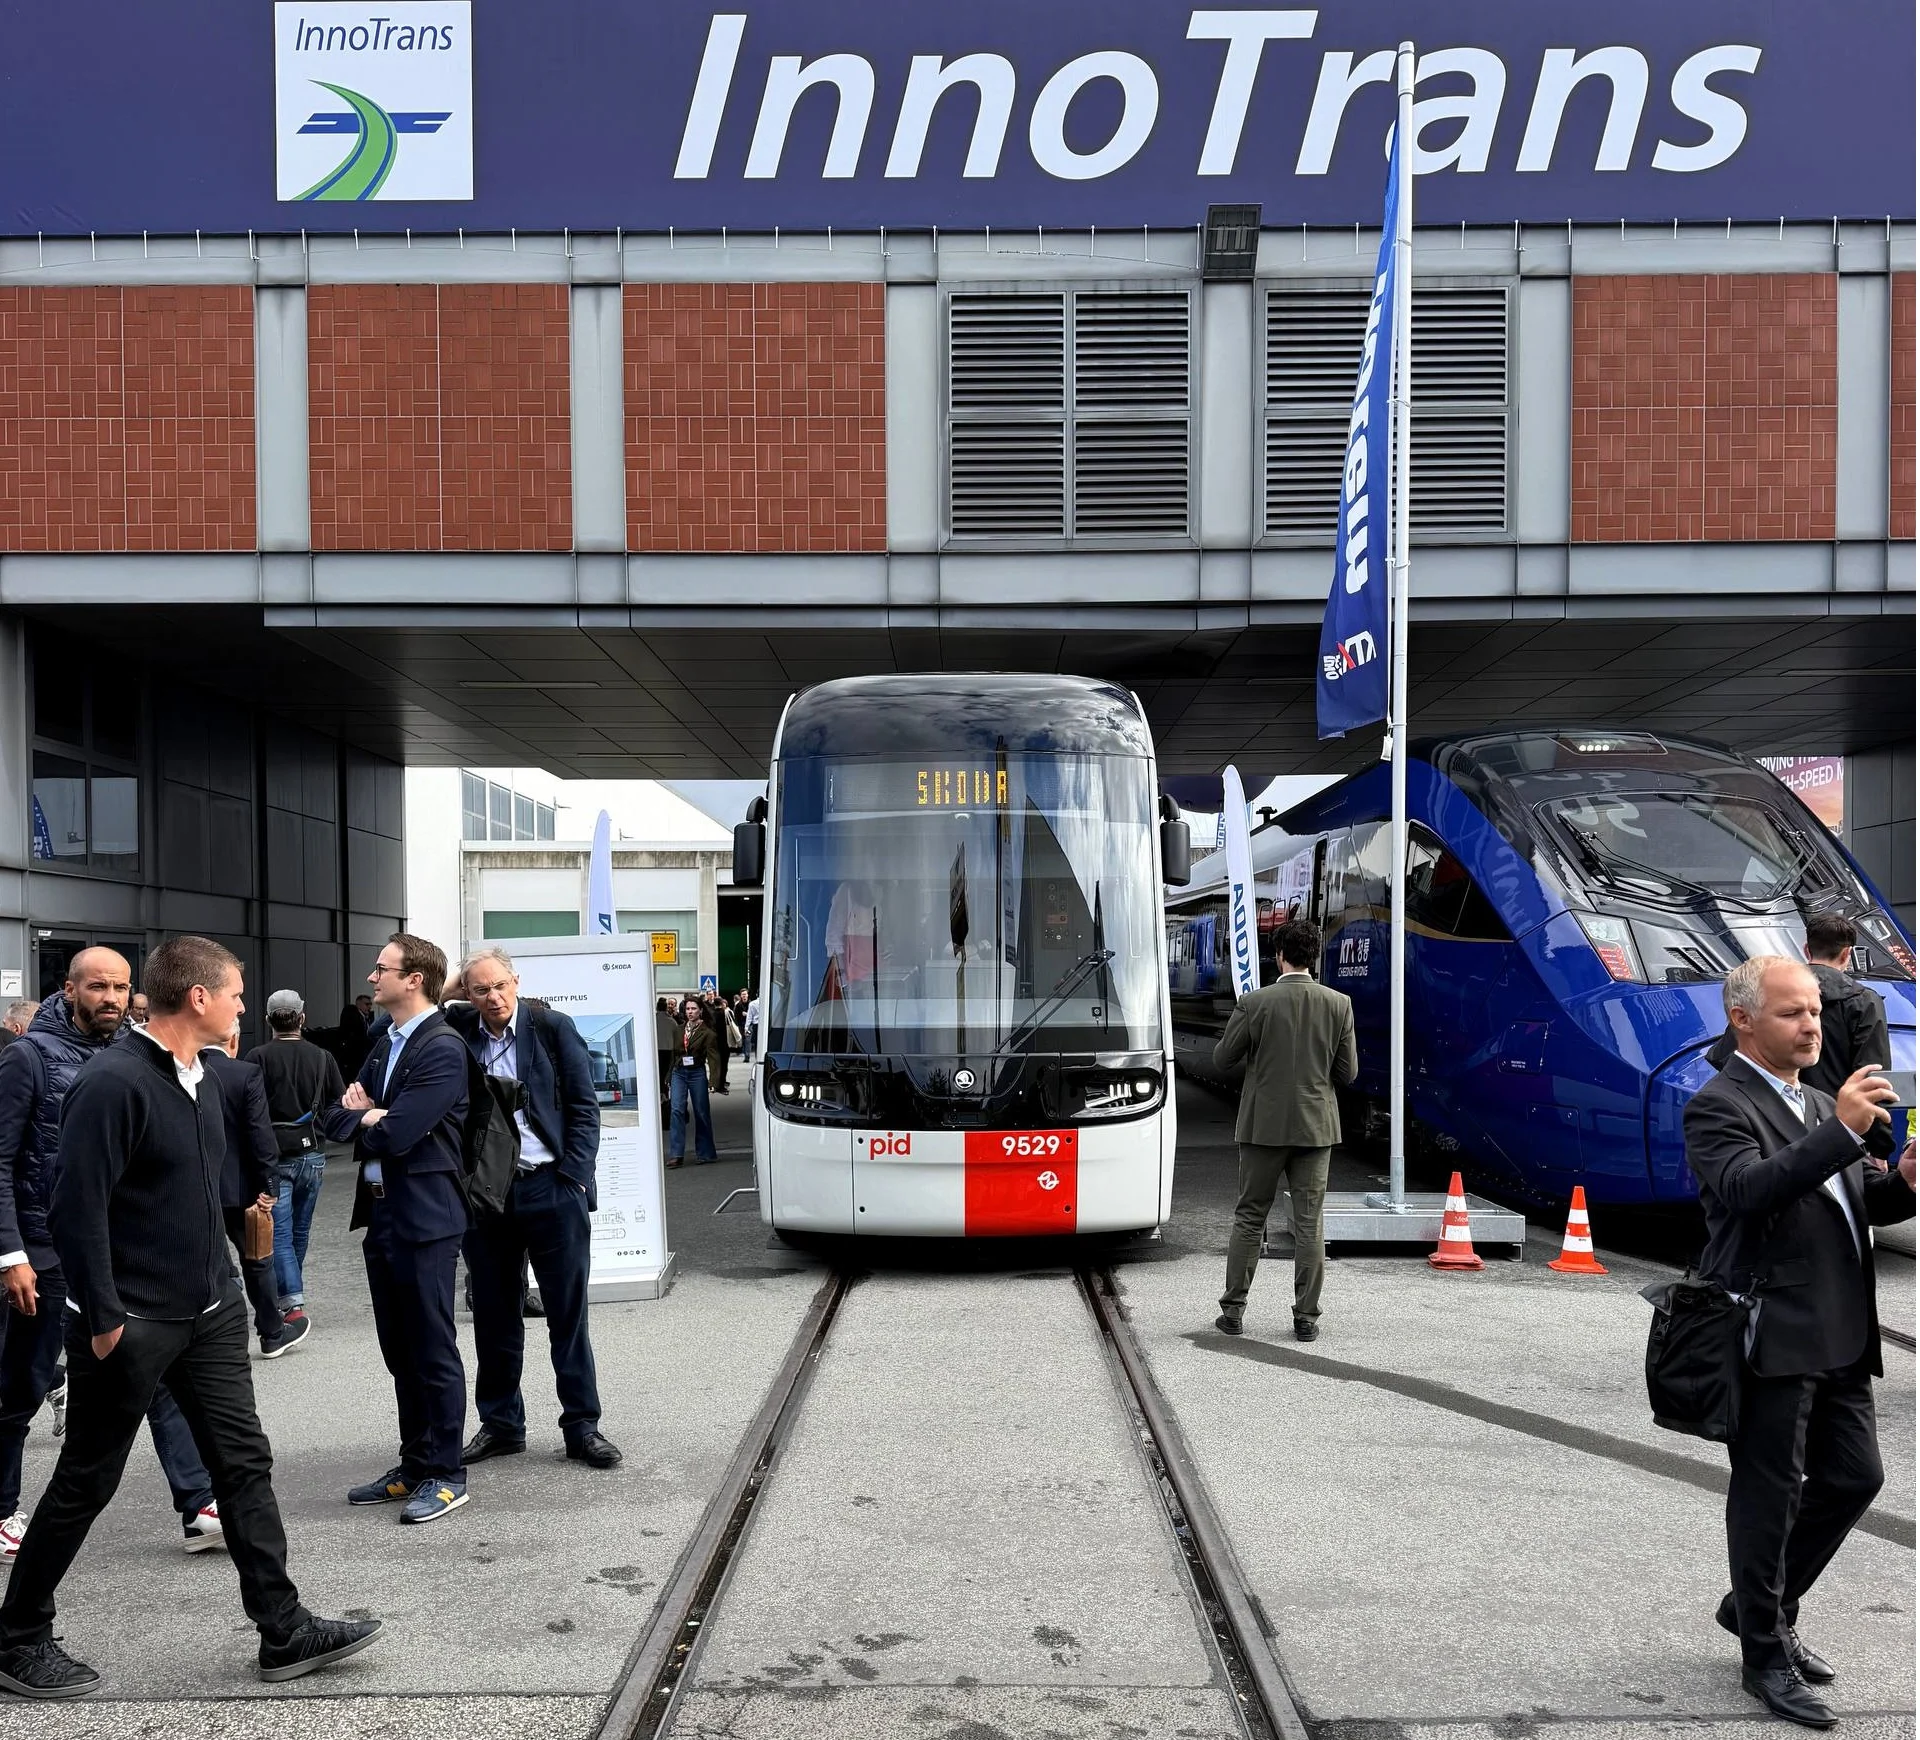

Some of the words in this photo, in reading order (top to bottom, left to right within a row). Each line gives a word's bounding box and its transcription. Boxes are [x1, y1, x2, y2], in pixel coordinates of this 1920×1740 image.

[294, 18, 454, 52] InnoTrans
[674, 10, 1763, 180] InnoTrans
[869, 1132, 911, 1160] pid
[1001, 1135, 1060, 1156] 9529
